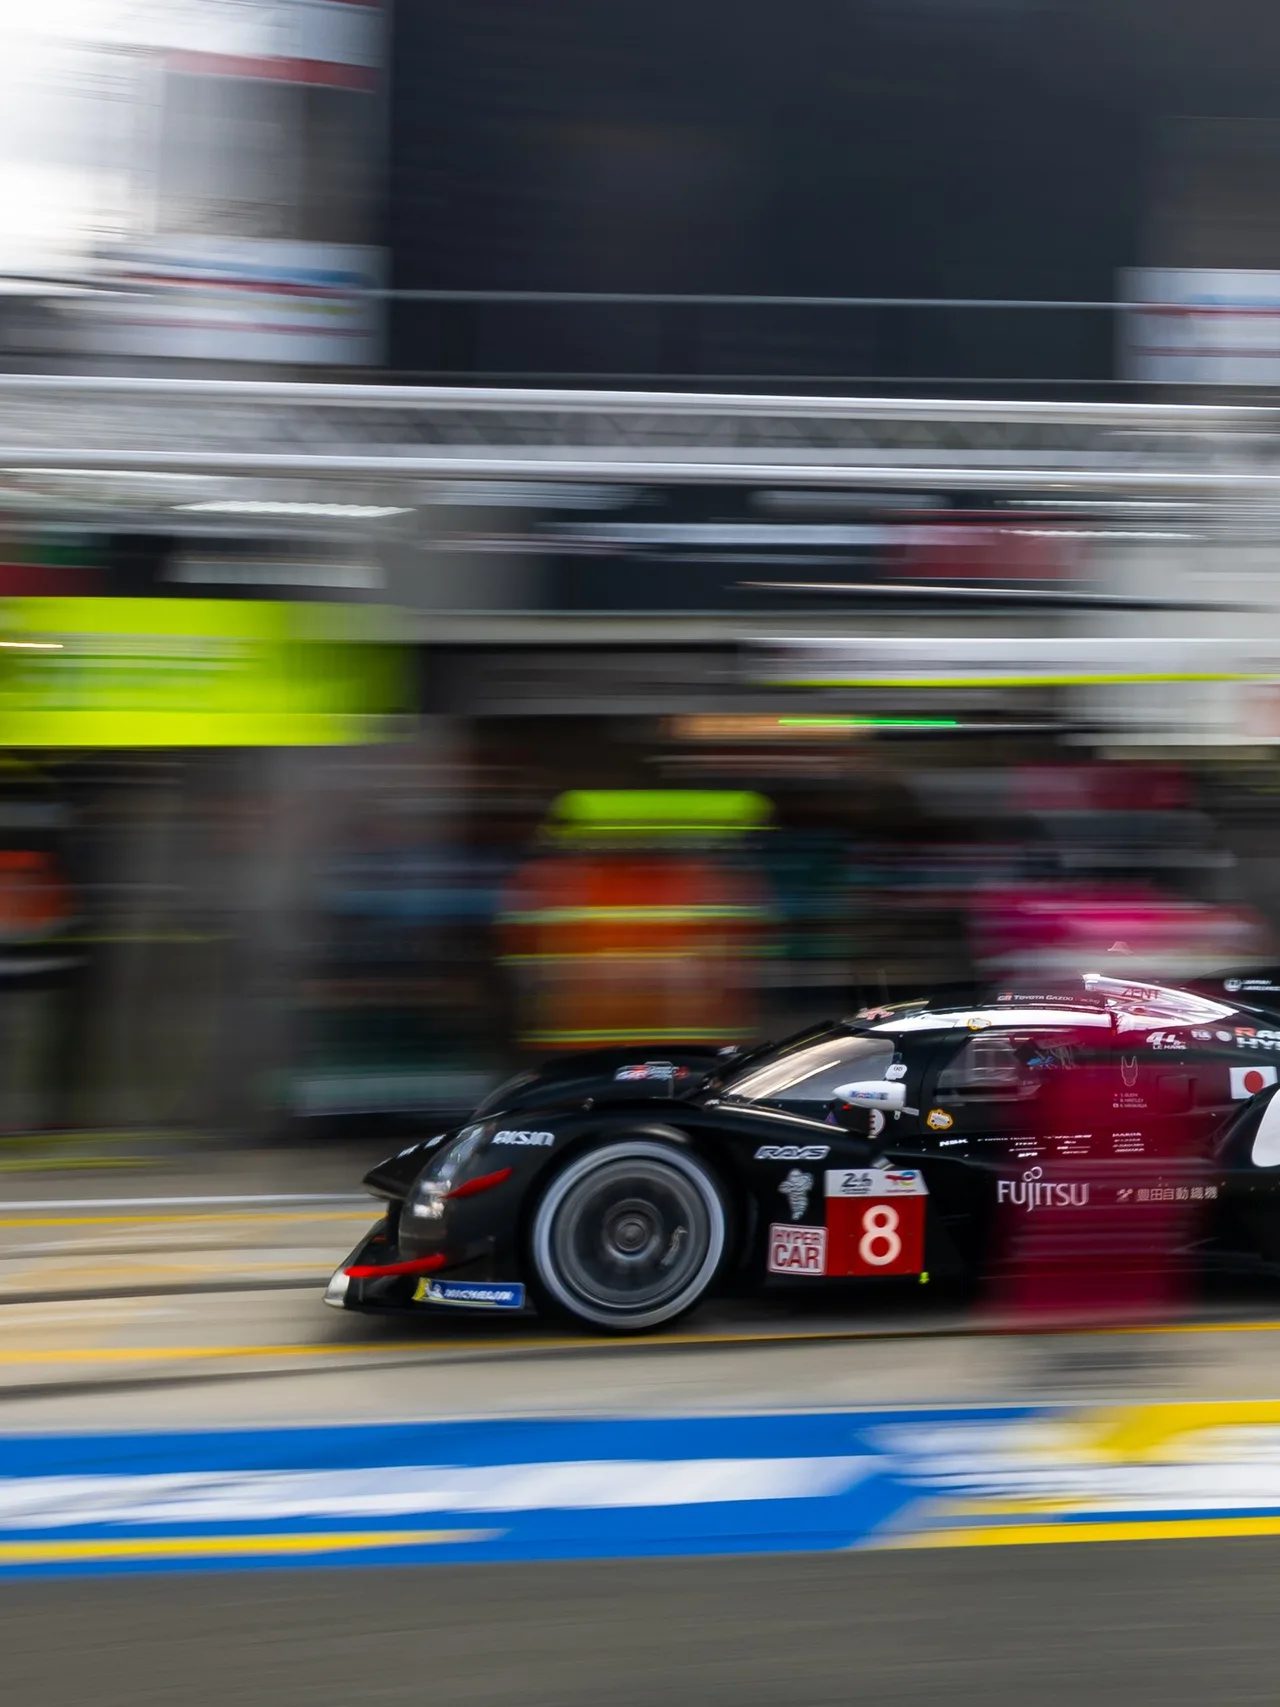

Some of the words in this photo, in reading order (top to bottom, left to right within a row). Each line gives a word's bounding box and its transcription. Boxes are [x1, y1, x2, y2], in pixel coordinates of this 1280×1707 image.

[491, 1130, 555, 1146] AISIN
[753, 1145, 831, 1160] RAYS
[997, 1180, 1090, 1213] FUJITSU
[774, 1230, 822, 1246] HYPER
[858, 1204, 902, 1266] 8
[774, 1244, 819, 1269] CAR
[444, 1288, 515, 1301] MICHELIN
